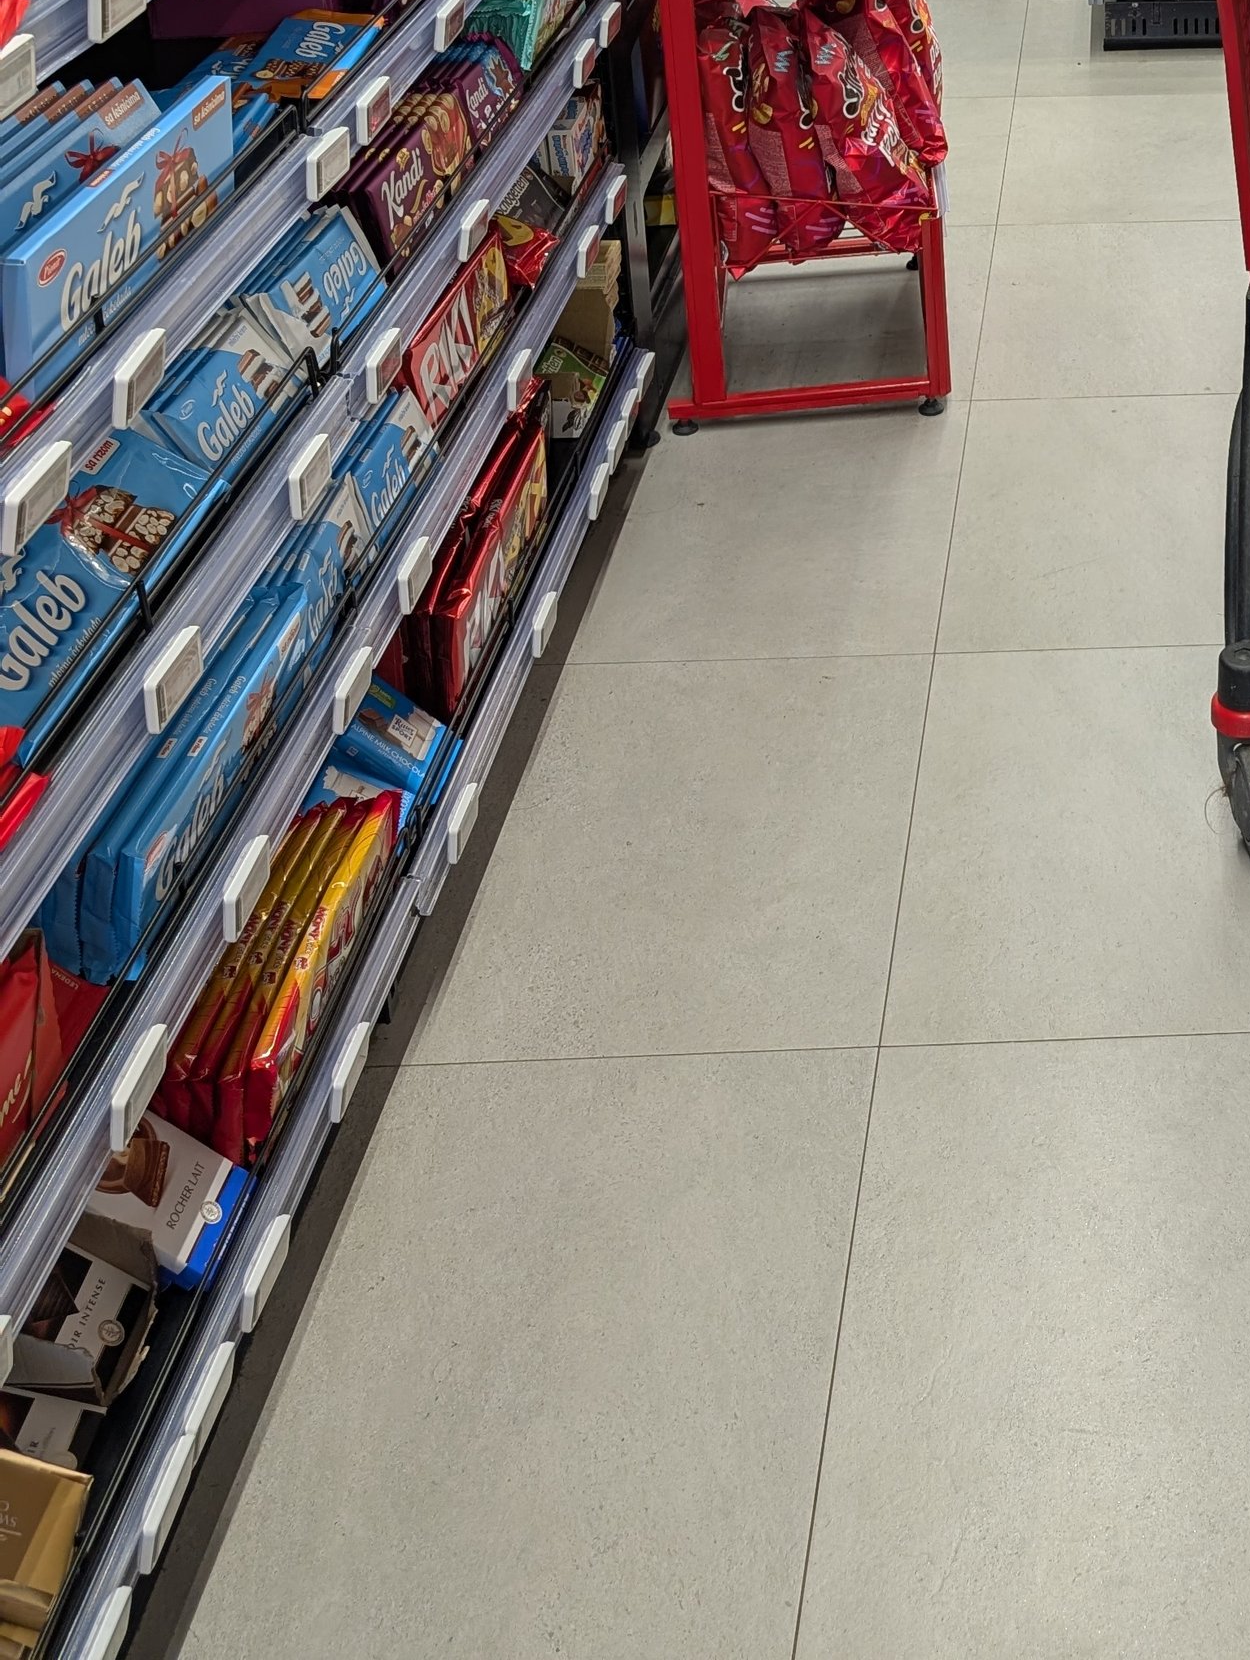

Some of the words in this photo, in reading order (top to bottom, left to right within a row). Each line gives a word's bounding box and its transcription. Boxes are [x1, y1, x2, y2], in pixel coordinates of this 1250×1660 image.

[295, 20, 345, 59] Galeb
[380, 148, 424, 211] Kandi
[61, 209, 141, 331] Galeb
[322, 240, 367, 295] Galeb
[197, 381, 255, 463] Galeb
[371, 464, 405, 528] Galeb
[351, 723, 375, 742] ALPINE
[374, 737, 391, 754] MILK
[392, 725, 412, 741] SPORT
[166, 1185, 193, 1231] ROCHER
[188, 1160, 205, 1186] LAIT
[80, 1276, 107, 1321] INTENSE
